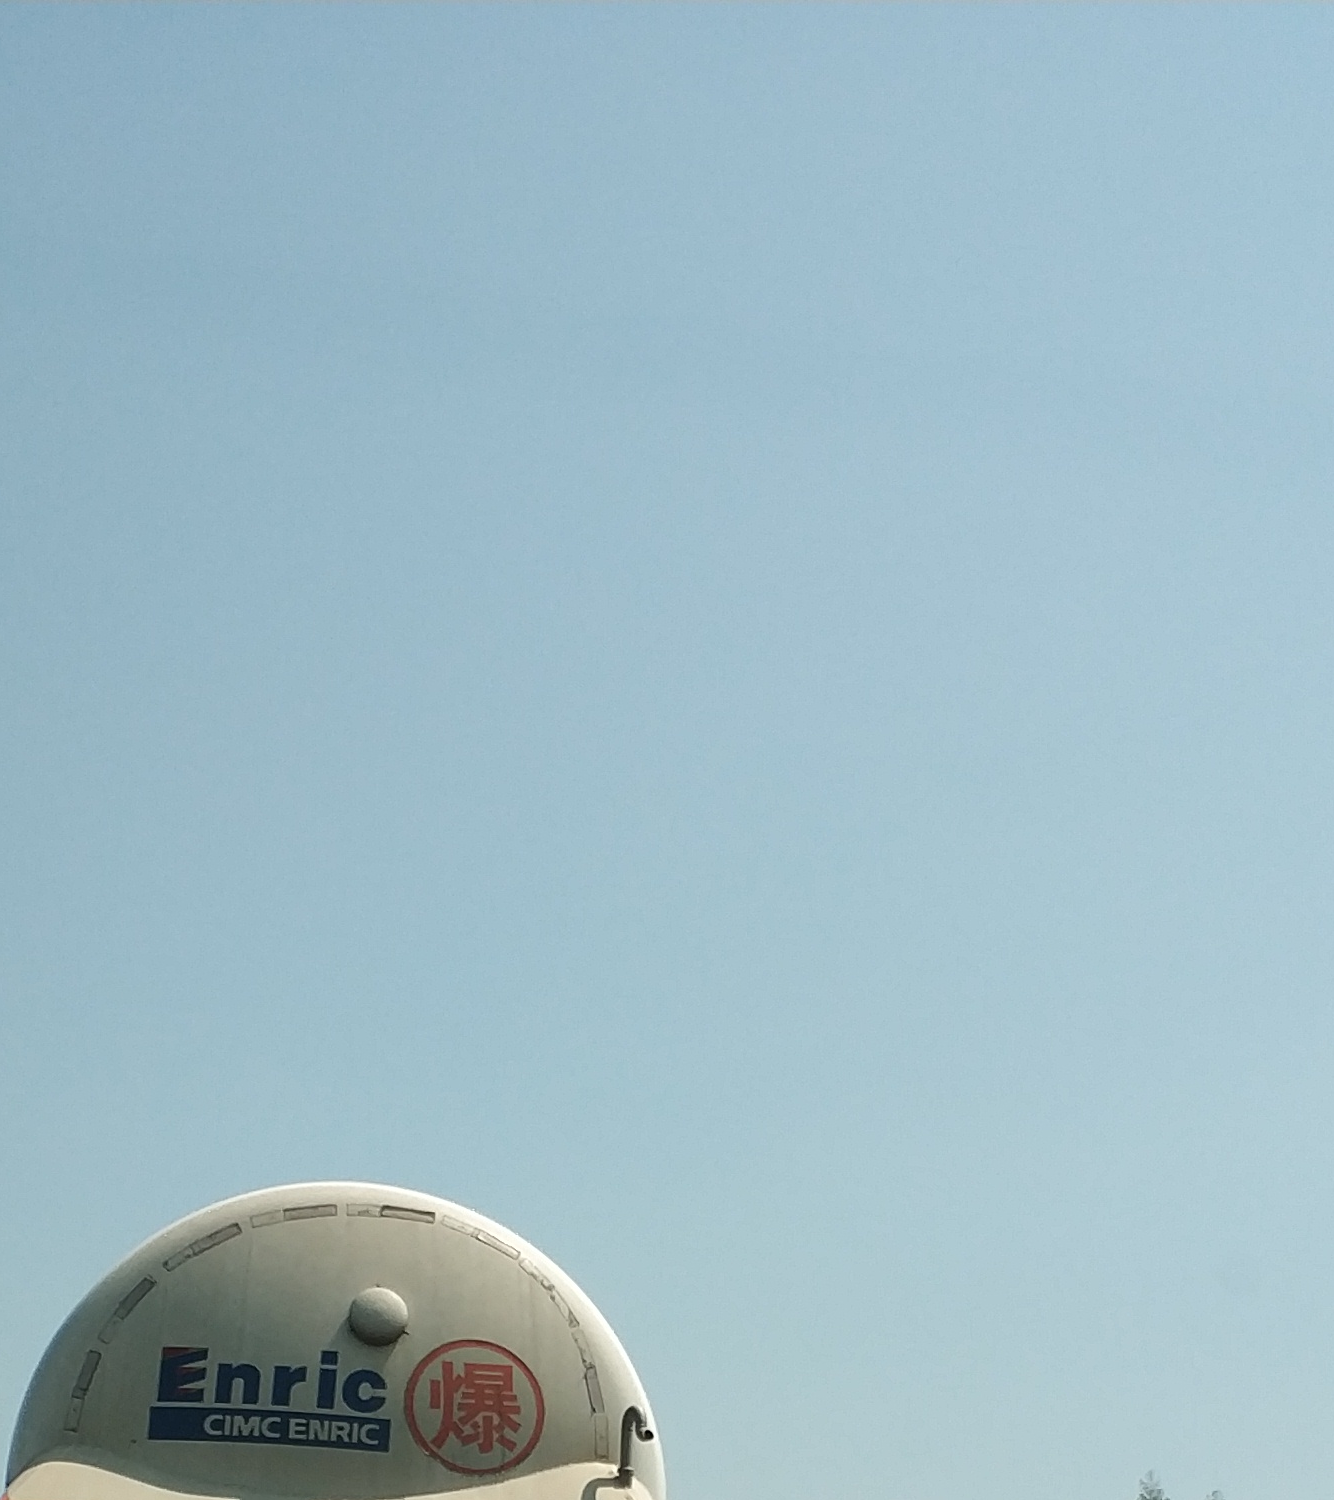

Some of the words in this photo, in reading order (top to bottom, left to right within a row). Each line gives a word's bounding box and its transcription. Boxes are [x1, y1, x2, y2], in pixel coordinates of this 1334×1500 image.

[157, 1347, 387, 1413] Enric
[430, 1361, 522, 1455] 爆
[203, 1414, 281, 1438] CIMC
[288, 1418, 380, 1446] ENRIC
